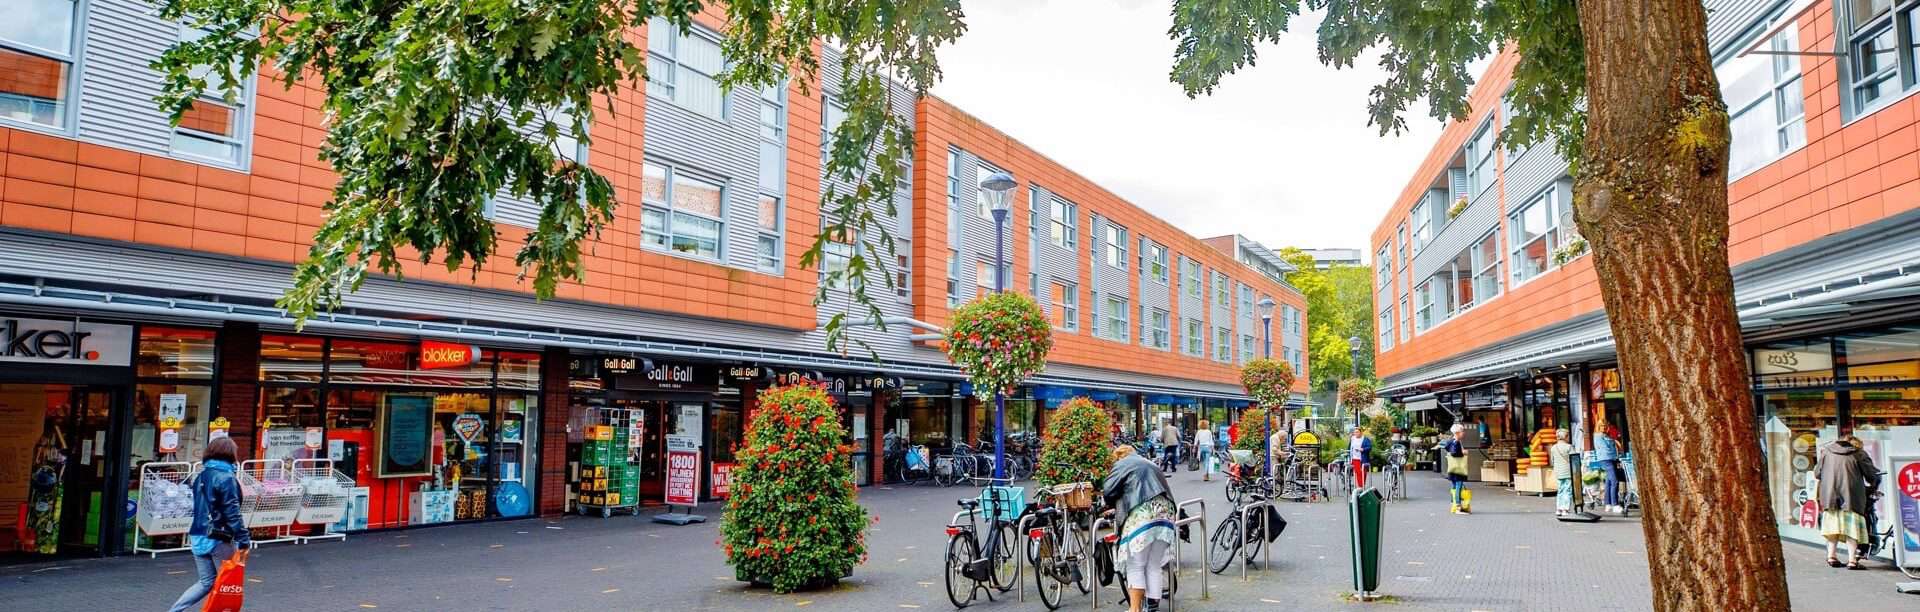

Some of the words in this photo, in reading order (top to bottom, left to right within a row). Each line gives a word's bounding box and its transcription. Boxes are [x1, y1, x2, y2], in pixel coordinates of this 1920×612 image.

[0, 319, 99, 360] ker.
[423, 347, 465, 362] blokker
[673, 366, 693, 382] Gall
[671, 455, 695, 469] 1800
